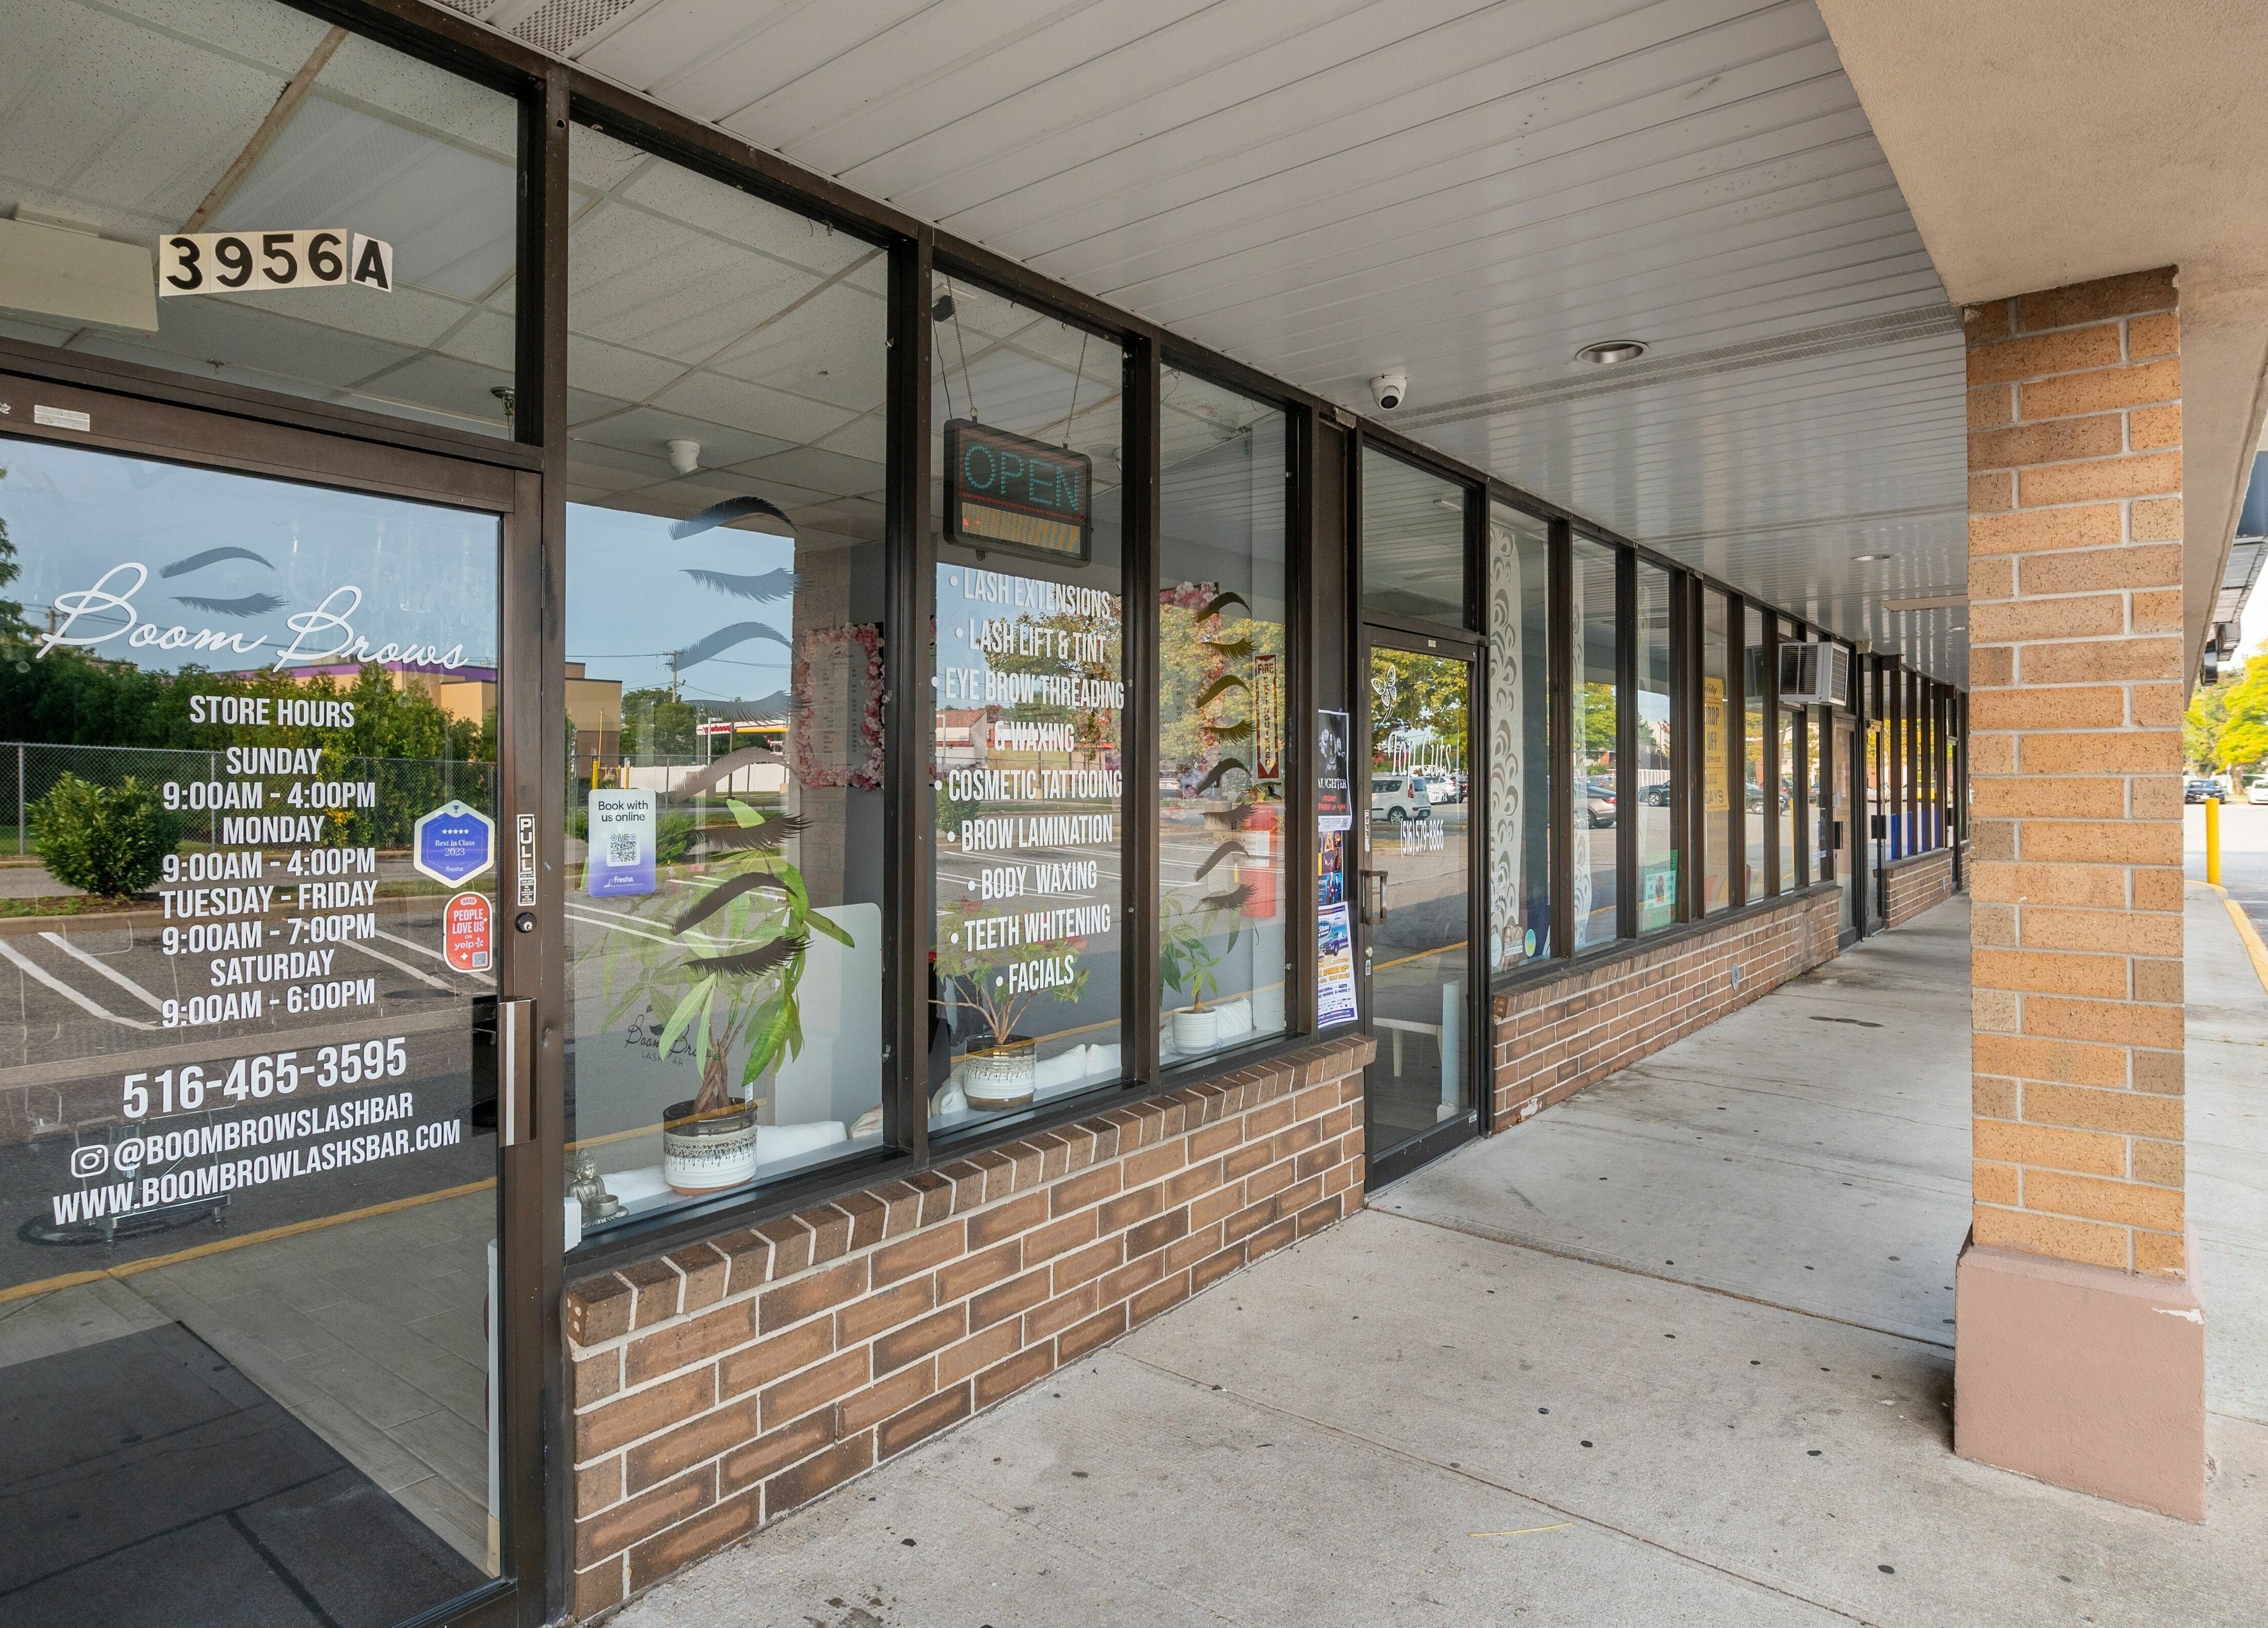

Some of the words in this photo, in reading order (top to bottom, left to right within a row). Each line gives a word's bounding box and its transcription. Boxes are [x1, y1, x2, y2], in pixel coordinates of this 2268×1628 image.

[964, 445, 1080, 512] OPEN
[963, 569, 1010, 605] LASH
[1015, 578, 1111, 620] EXTENSIONS
[37, 562, 268, 660] Boom
[273, 585, 470, 673] Brows
[969, 618, 1016, 655] LASH
[1019, 623, 1054, 657] LIFT
[1058, 629, 1068, 660] &
[1072, 631, 1106, 664] TINT
[1258, 663, 1274, 675] FIRE
[945, 667, 980, 701] EYE
[985, 670, 1038, 705] BROW
[1041, 675, 1125, 710] THREADING
[1705, 683, 1718, 699] lity
[190, 695, 270, 726] STORE
[277, 698, 355, 728] HOURS
[994, 721, 1005, 751] &
[1011, 721, 1075, 753] WAXING
[1707, 732, 1718, 751] OFF
[226, 746, 322, 775] SUNDAY
[1388, 731, 1417, 792] Top
[1421, 732, 1452, 777] Cuts
[162, 782, 263, 810] 9:00AM
[287, 781, 376, 809] 4:00PM
[949, 769, 1037, 802] COSMETIC
[1041, 770, 1123, 800] TATTOOING
[598, 800, 624, 810] Book
[627, 800, 649, 810] with
[615, 812, 646, 822] online
[223, 815, 325, 845] MONDAY
[520, 818, 533, 871] PULL
[962, 819, 1014, 852] BROW
[1018, 815, 1113, 849] LAMINATION
[1400, 818, 1415, 858] (516)
[1415, 819, 1444, 852] 579-8866
[162, 851, 263, 883] 9:00AM
[286, 847, 375, 877] 4:00PM
[980, 865, 1027, 900] BODY
[1037, 860, 1098, 895] WAXING
[159, 885, 274, 919] TUESDAY
[298, 880, 378, 911] FRIDAY
[453, 909, 484, 922] PEOPLE
[161, 920, 264, 956] 9:00AM
[288, 913, 375, 944] 7:00PM
[452, 922, 473, 935] LOVE
[474, 921, 484, 933] US
[454, 940, 474, 951] yelp
[964, 917, 1021, 952] TEETH
[1024, 904, 1111, 948] WHITENING
[210, 949, 335, 987] SATURDAY
[1009, 955, 1074, 995] FACIALS
[161, 988, 262, 1028] 9:00AM
[286, 979, 375, 1014] 6:00PM
[122, 1037, 407, 1119] 516-465-3595
[113, 1092, 414, 1172] @BOOMBROWSLASHBAR
[53, 1118, 462, 1225] WWW.BOOMBROWLASHSBAR.COM
